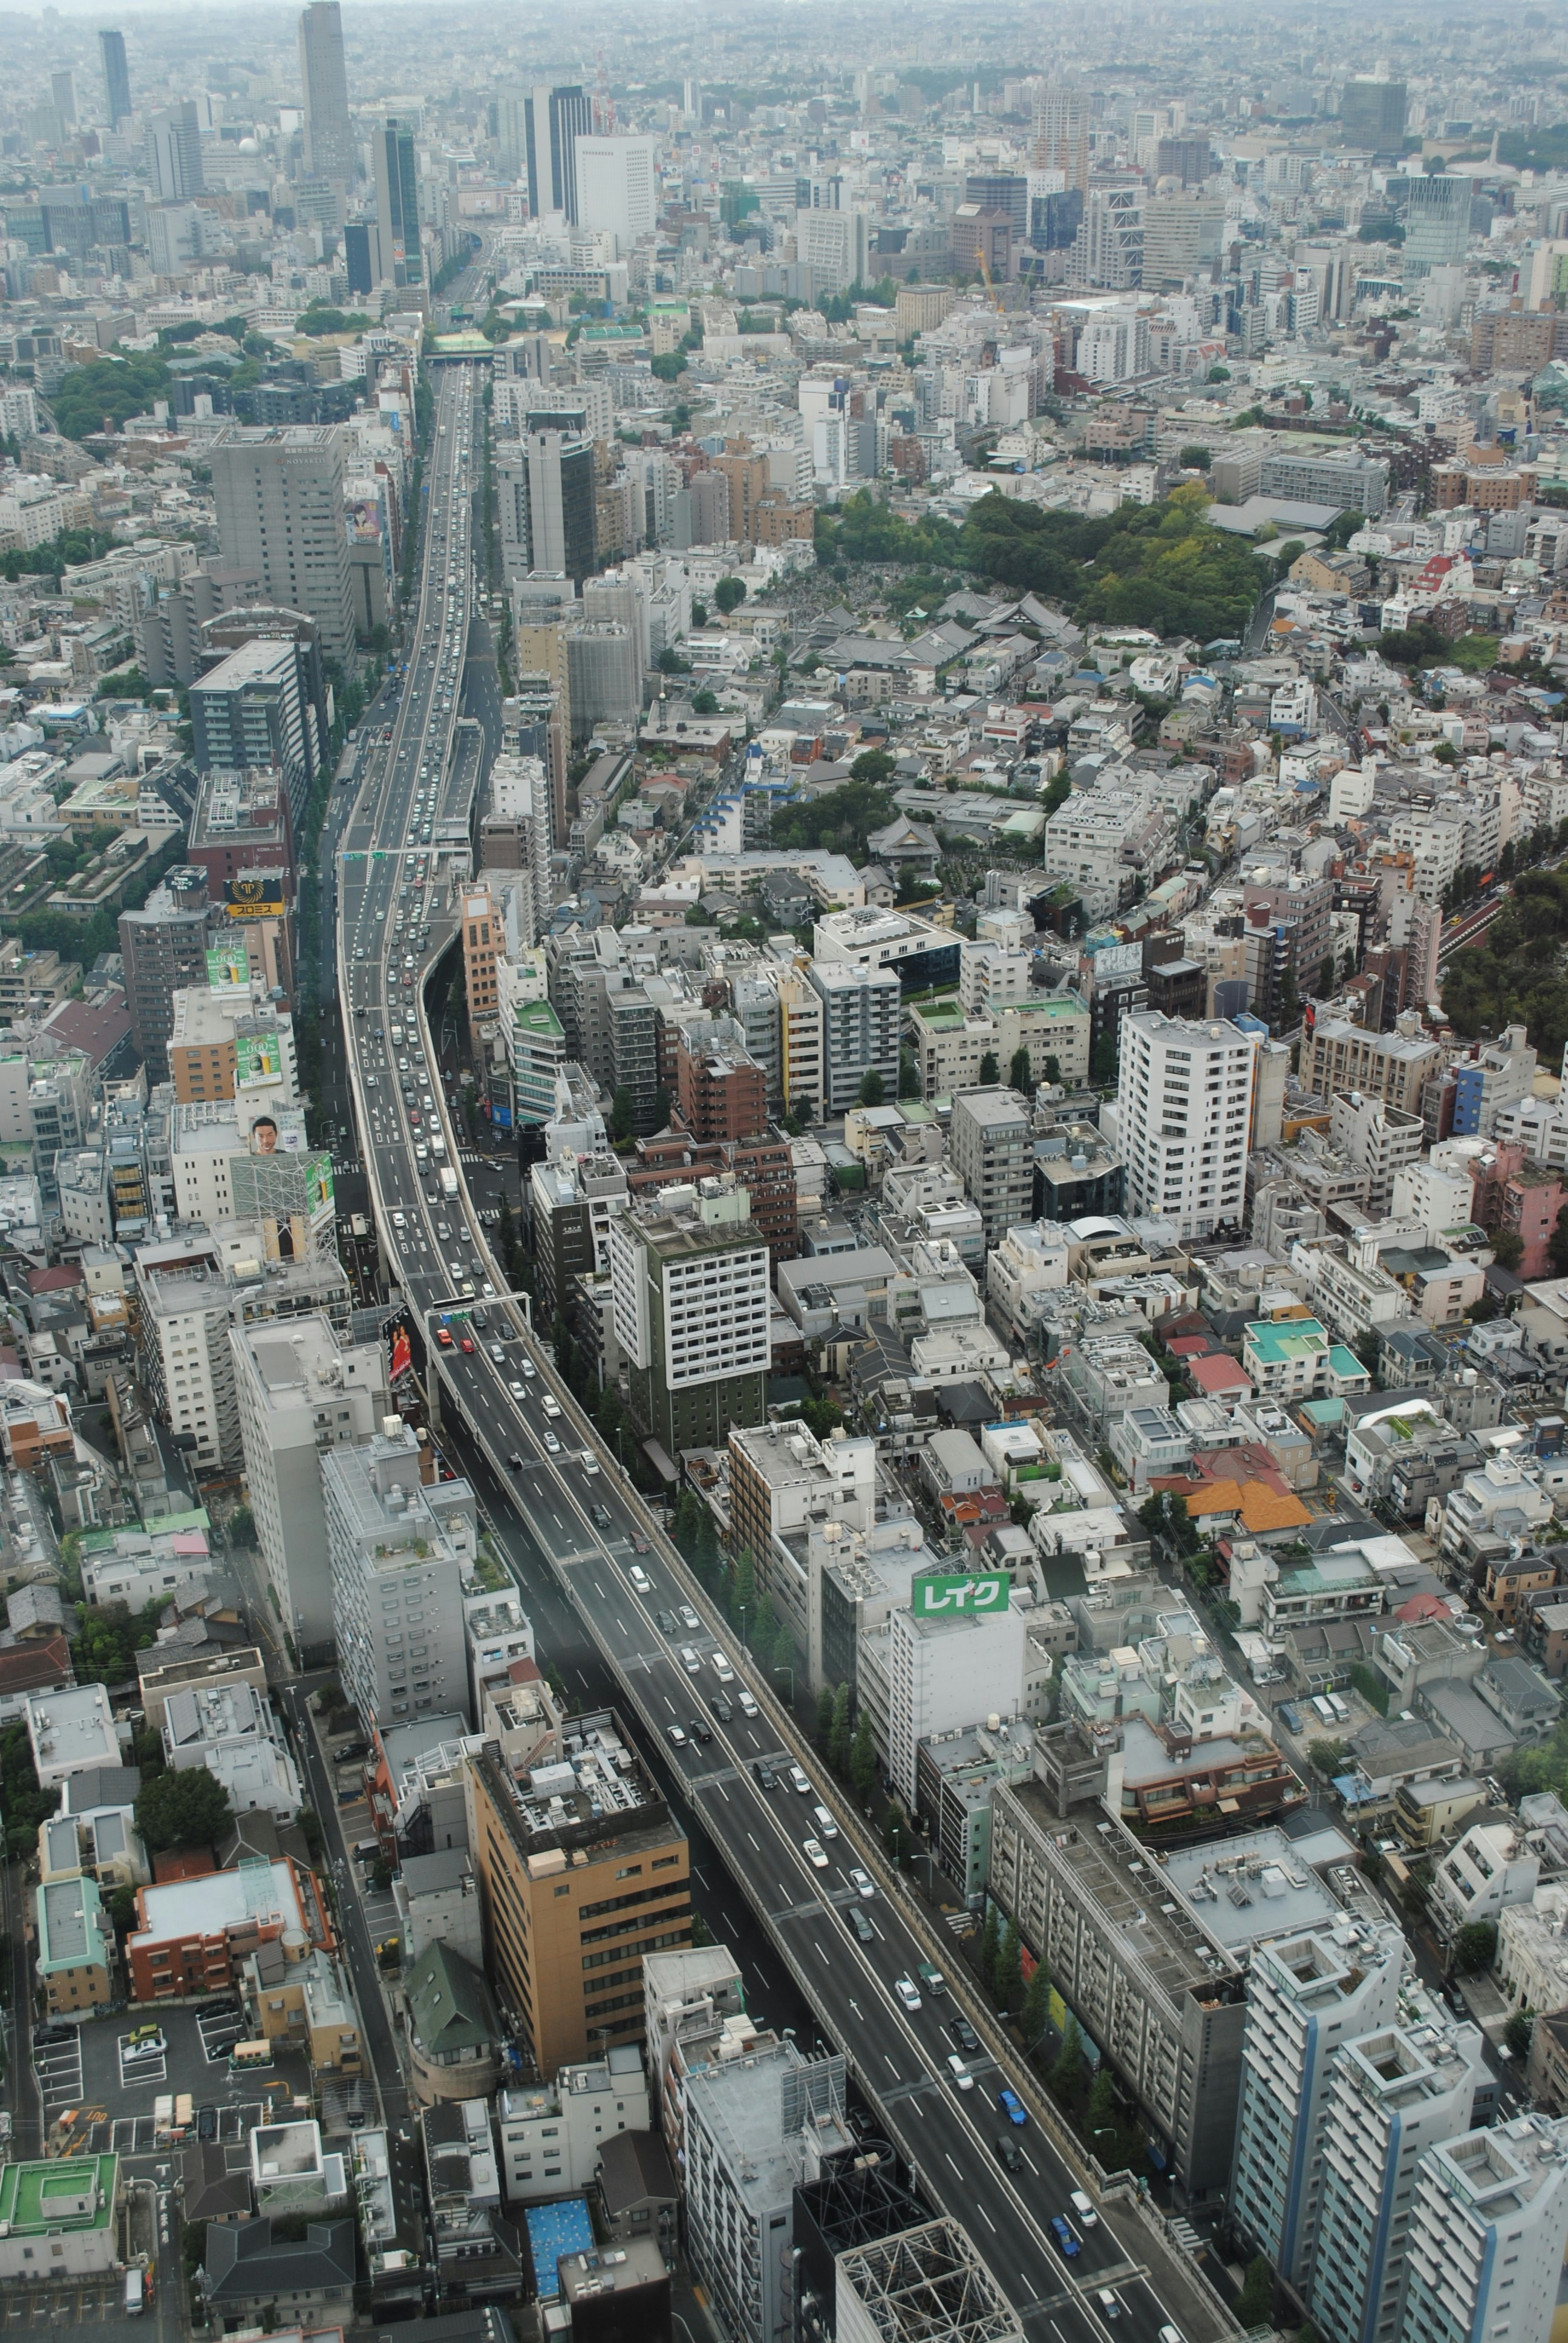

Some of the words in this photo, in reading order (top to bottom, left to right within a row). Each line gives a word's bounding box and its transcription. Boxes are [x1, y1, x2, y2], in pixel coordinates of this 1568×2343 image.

[237, 905, 272, 914] プロミス
[925, 1581, 999, 1610] レイク
[85, 2111, 108, 2121] OUT
[160, 2195, 170, 2244] 止まれ
